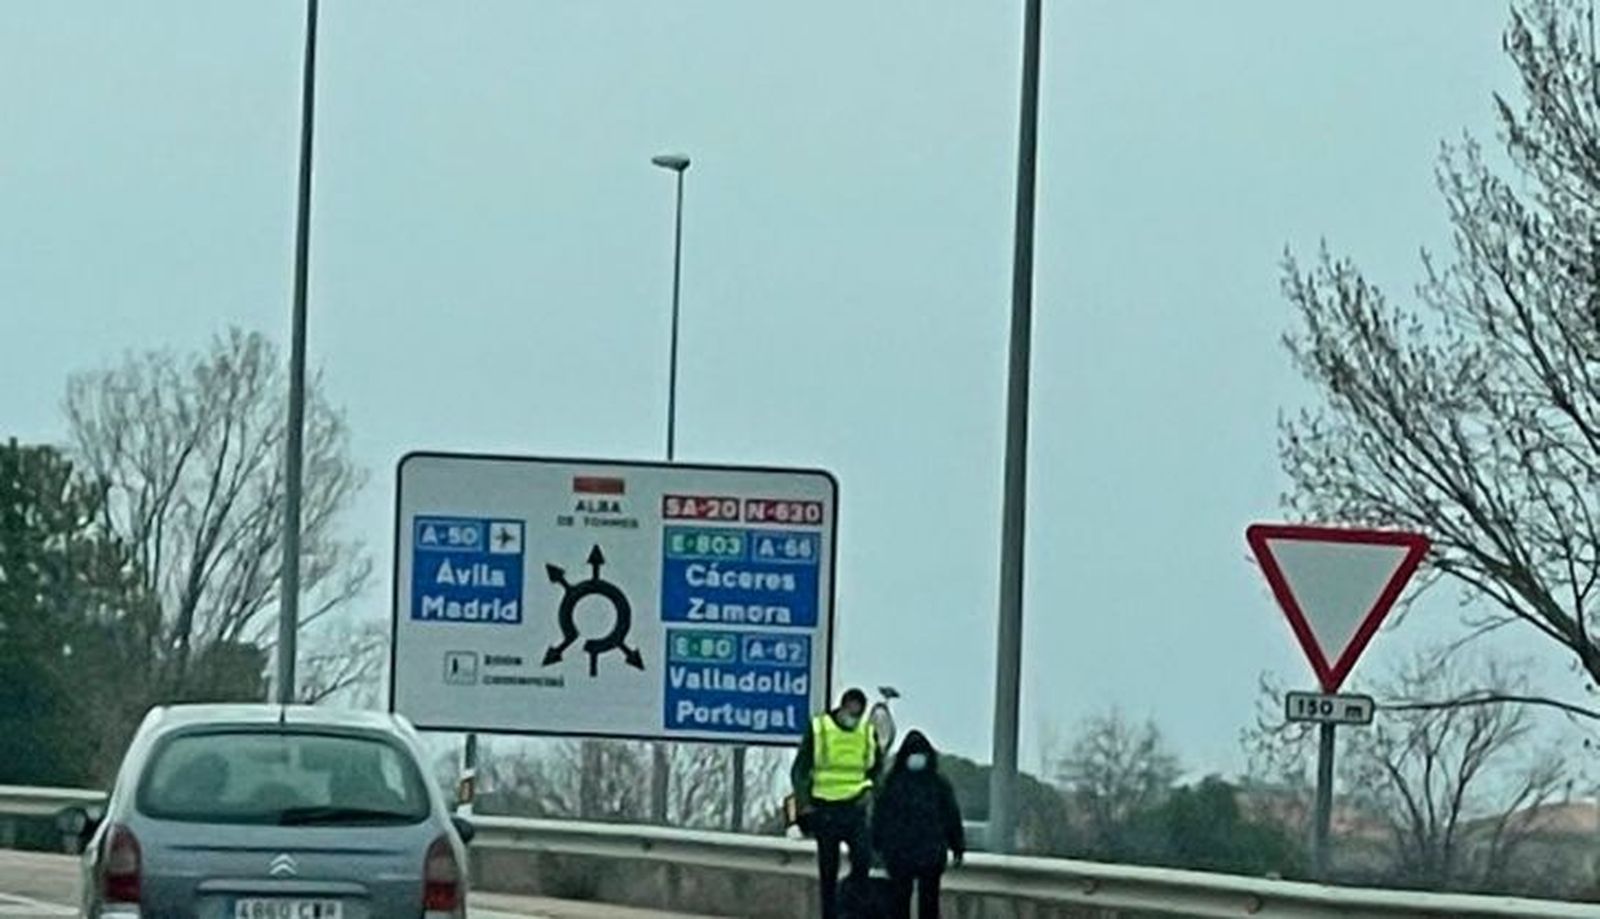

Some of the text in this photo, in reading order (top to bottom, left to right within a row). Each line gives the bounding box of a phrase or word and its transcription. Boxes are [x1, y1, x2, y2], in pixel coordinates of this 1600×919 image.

[575, 500, 621, 513] ALBA
[665, 498, 737, 518] SA-20
[421, 525, 478, 546] A-50
[672, 534, 741, 555] E-803
[759, 538, 812, 558] A-66
[436, 558, 506, 587] Ávila
[685, 562, 796, 591] Cáceres
[421, 595, 518, 621] Madrid
[687, 598, 791, 624] Zamora
[676, 636, 731, 658] E-80
[750, 640, 801, 662] A-62
[669, 666, 808, 696] Valladolid
[676, 700, 796, 731] Portugal
[1298, 699, 1363, 719] 150 m
